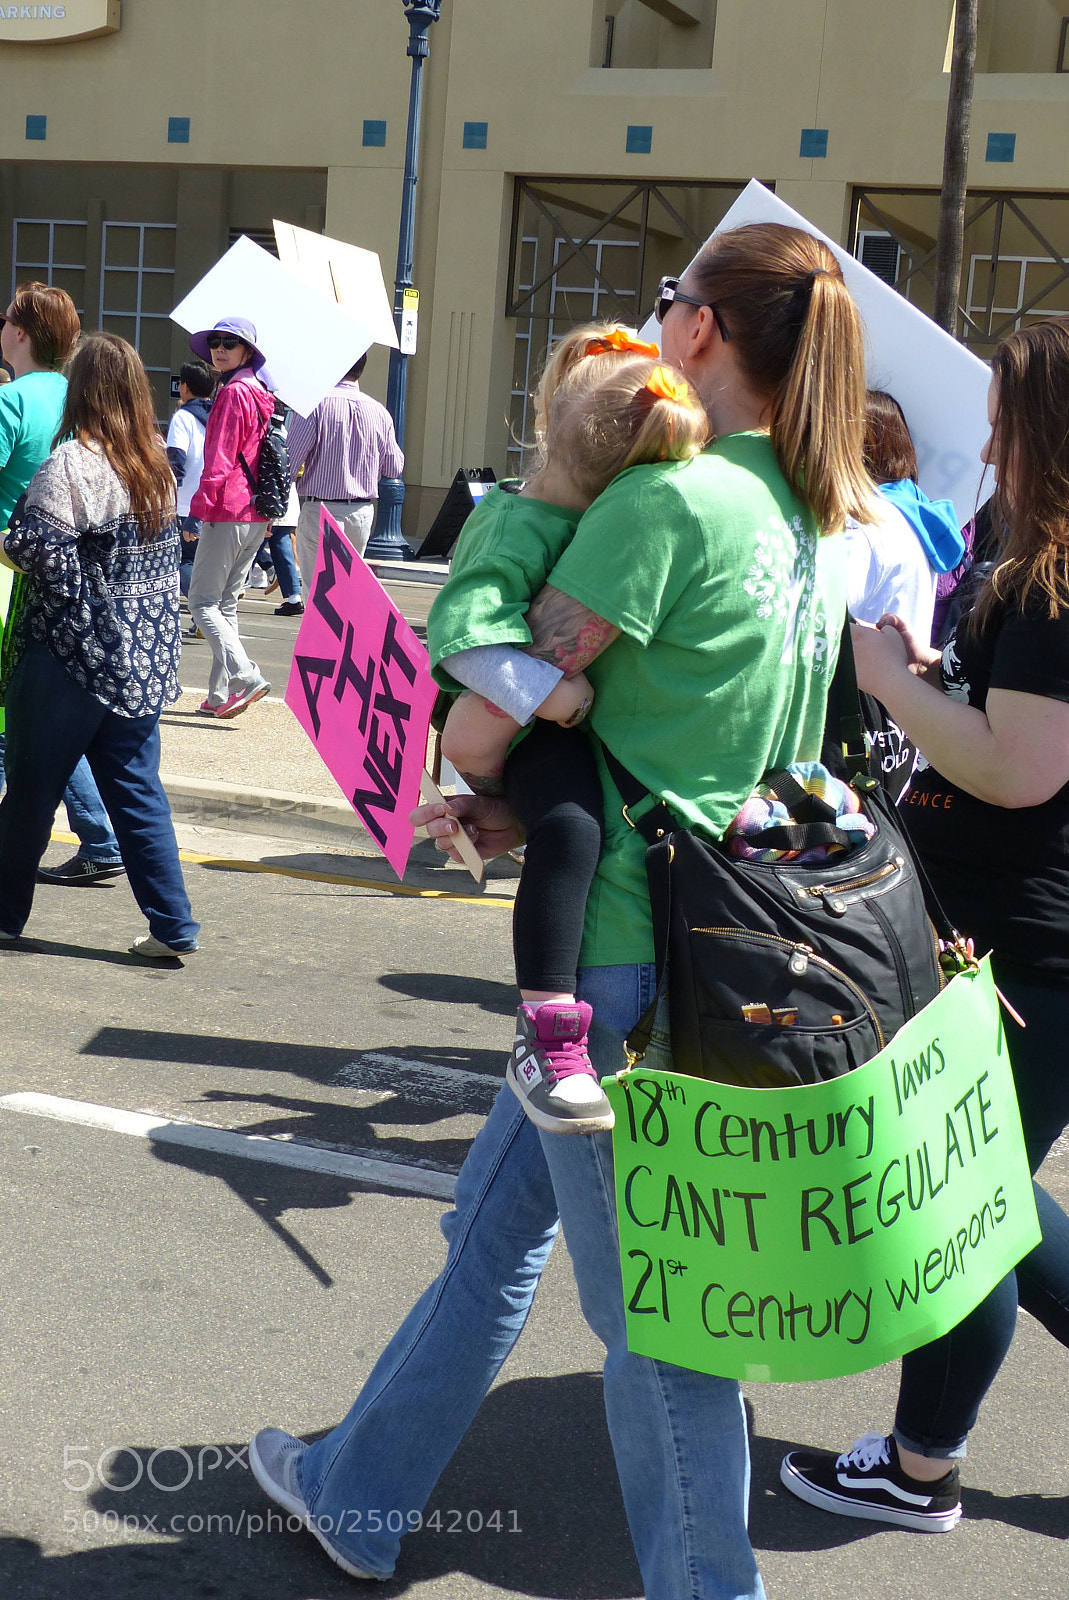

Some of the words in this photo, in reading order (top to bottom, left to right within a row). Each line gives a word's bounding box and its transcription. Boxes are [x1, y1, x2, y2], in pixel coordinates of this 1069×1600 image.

[352, 610, 418, 848] NEXT
[891, 1038, 946, 1116] laws
[800, 1071, 999, 1252] REGULATE
[885, 1185, 1008, 1312] weapons
